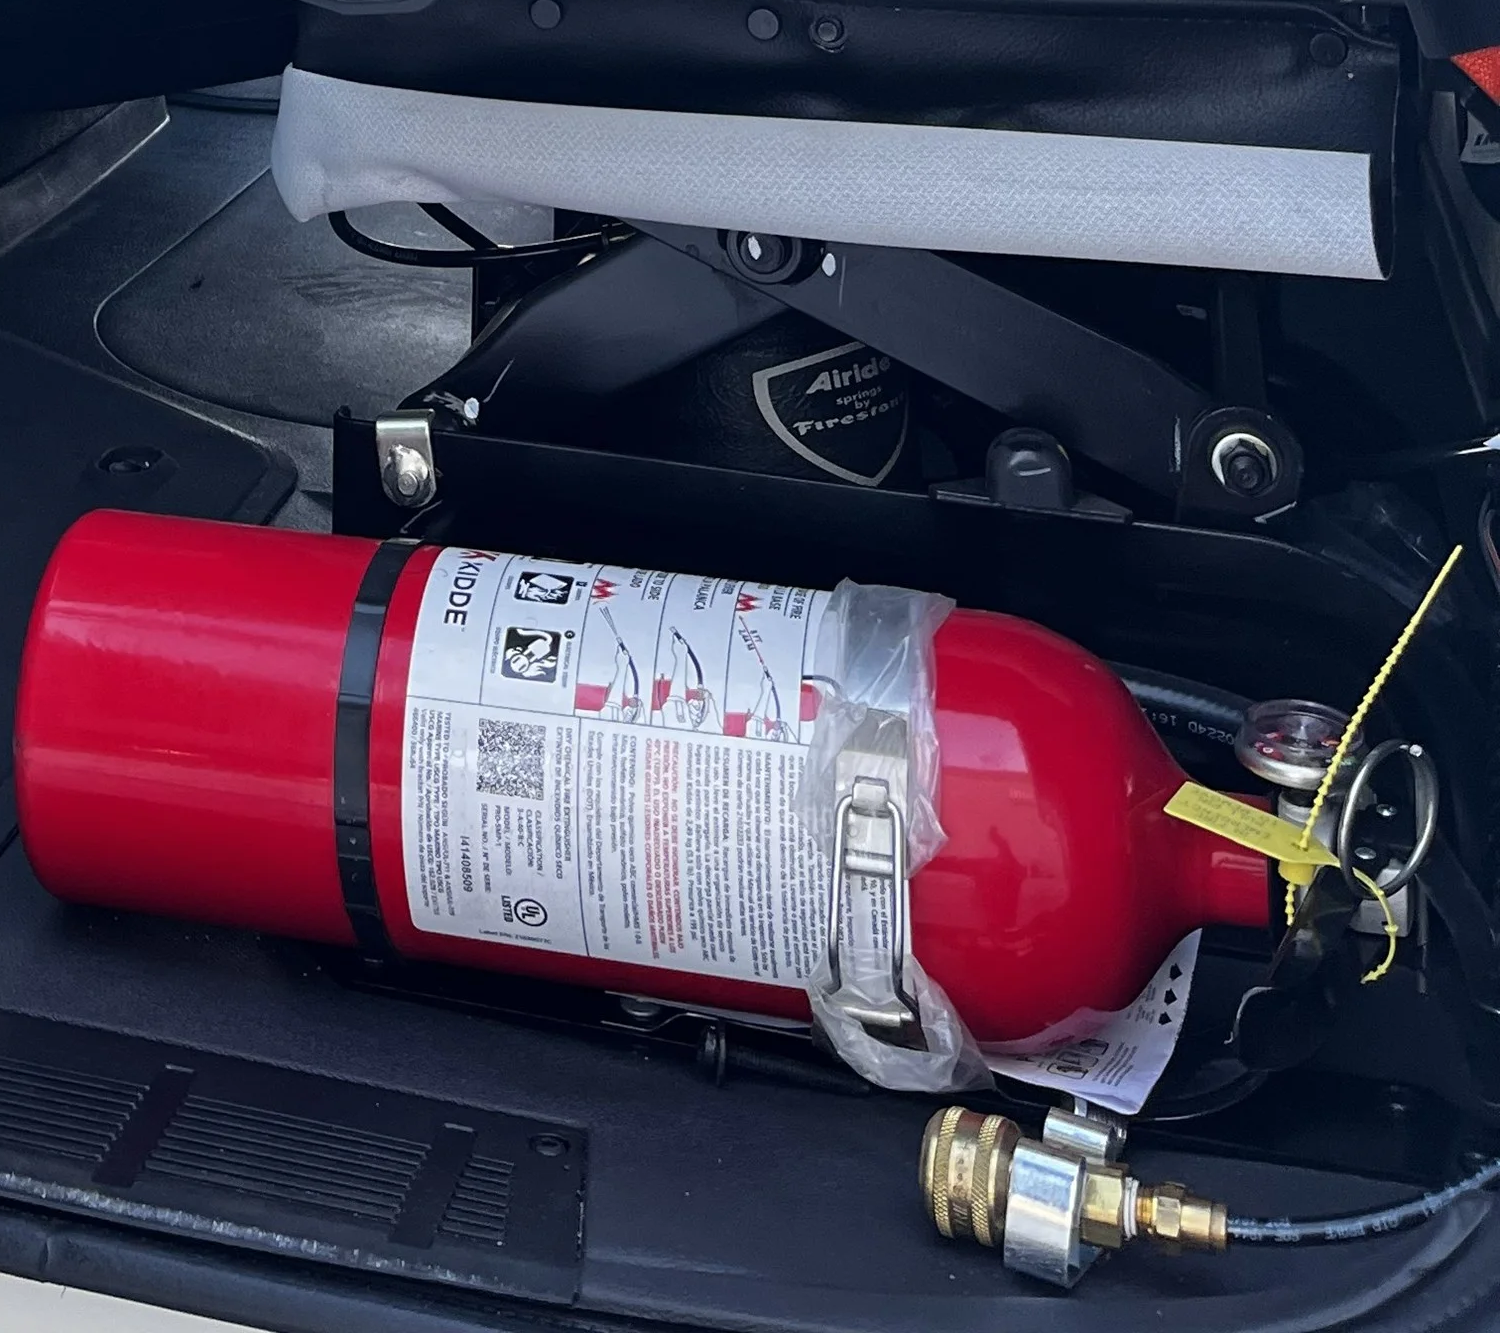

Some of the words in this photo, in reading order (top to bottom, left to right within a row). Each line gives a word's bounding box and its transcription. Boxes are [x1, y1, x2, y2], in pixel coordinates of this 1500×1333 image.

[805, 355, 892, 395] Airide
[835, 385, 883, 407] springs
[854, 398, 870, 411] by
[443, 560, 484, 626] KIDDE
[647, 587, 662, 601] SIDE
[789, 605, 805, 619] FIRE
[443, 713, 451, 740] TESTED
[443, 742, 449, 752] TO
[555, 767, 562, 777] DE
[564, 746, 572, 786] CHEMICAL
[723, 789, 729, 799] DE
[535, 810, 543, 871] CLASSIFICATION
[563, 807, 572, 861] EXTINGUISHER
[483, 862, 489, 872] DE
[501, 895, 513, 922] LISTED
[521, 906, 540, 919] UL
